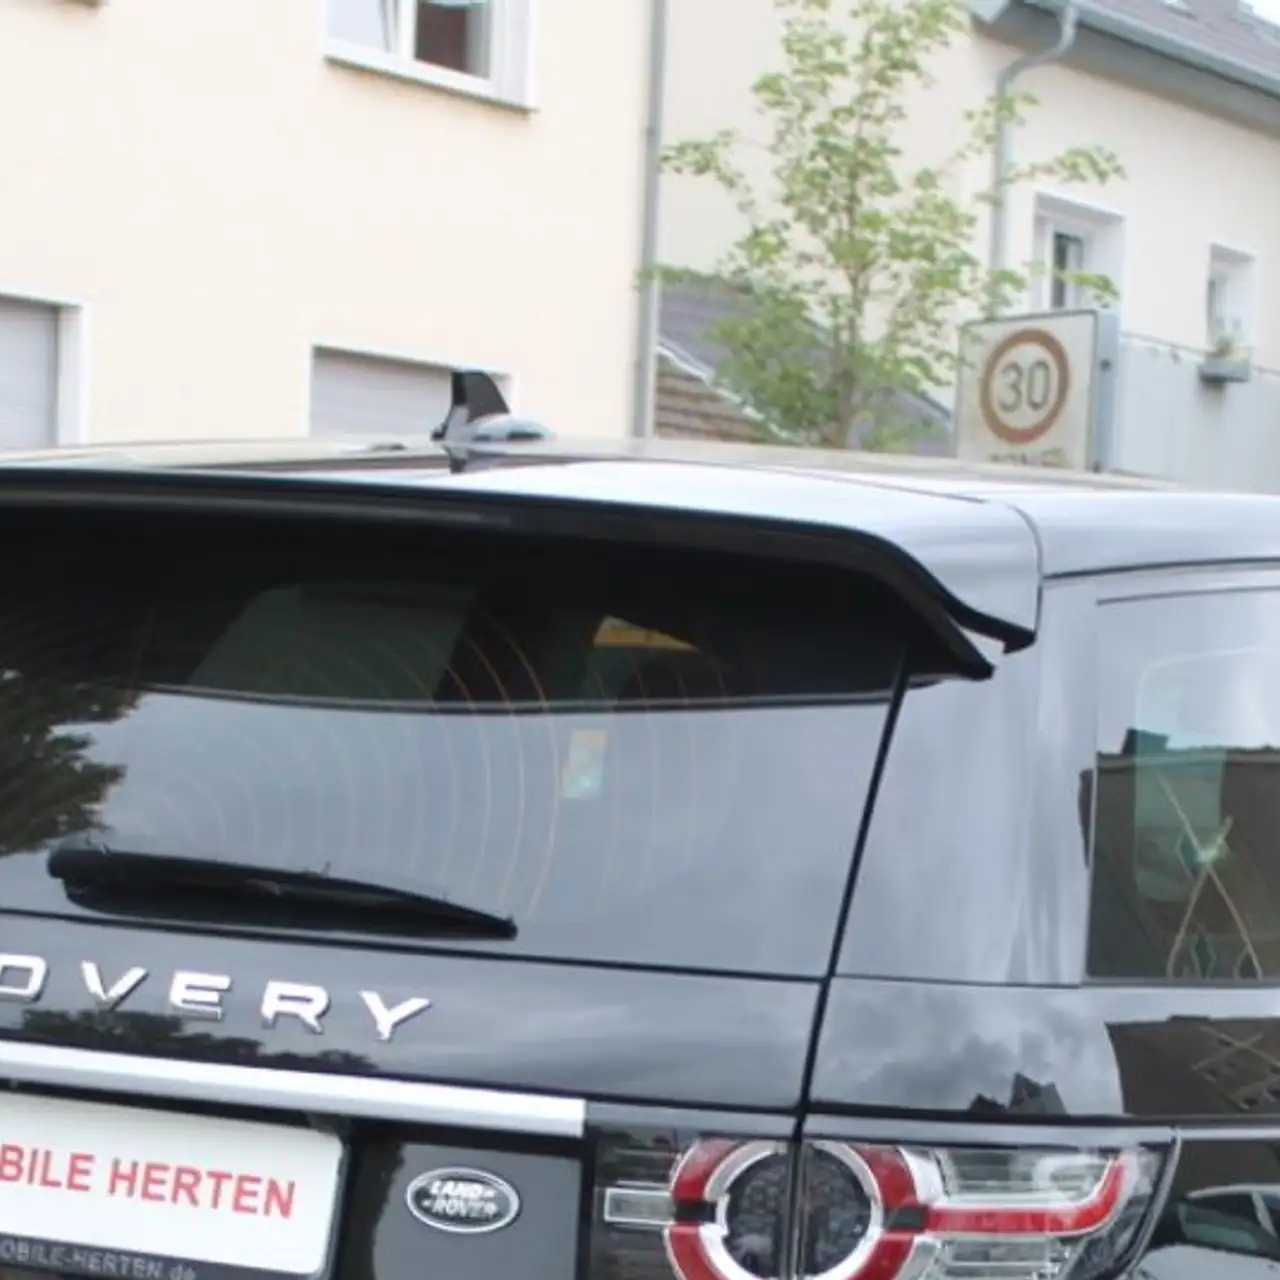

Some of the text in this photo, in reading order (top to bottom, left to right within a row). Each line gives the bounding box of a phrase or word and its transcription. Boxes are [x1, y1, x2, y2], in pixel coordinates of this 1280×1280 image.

[998, 360, 1051, 413] 30
[108, 1158, 297, 1219] HERTEN
[429, 1180, 484, 1199] LAND
